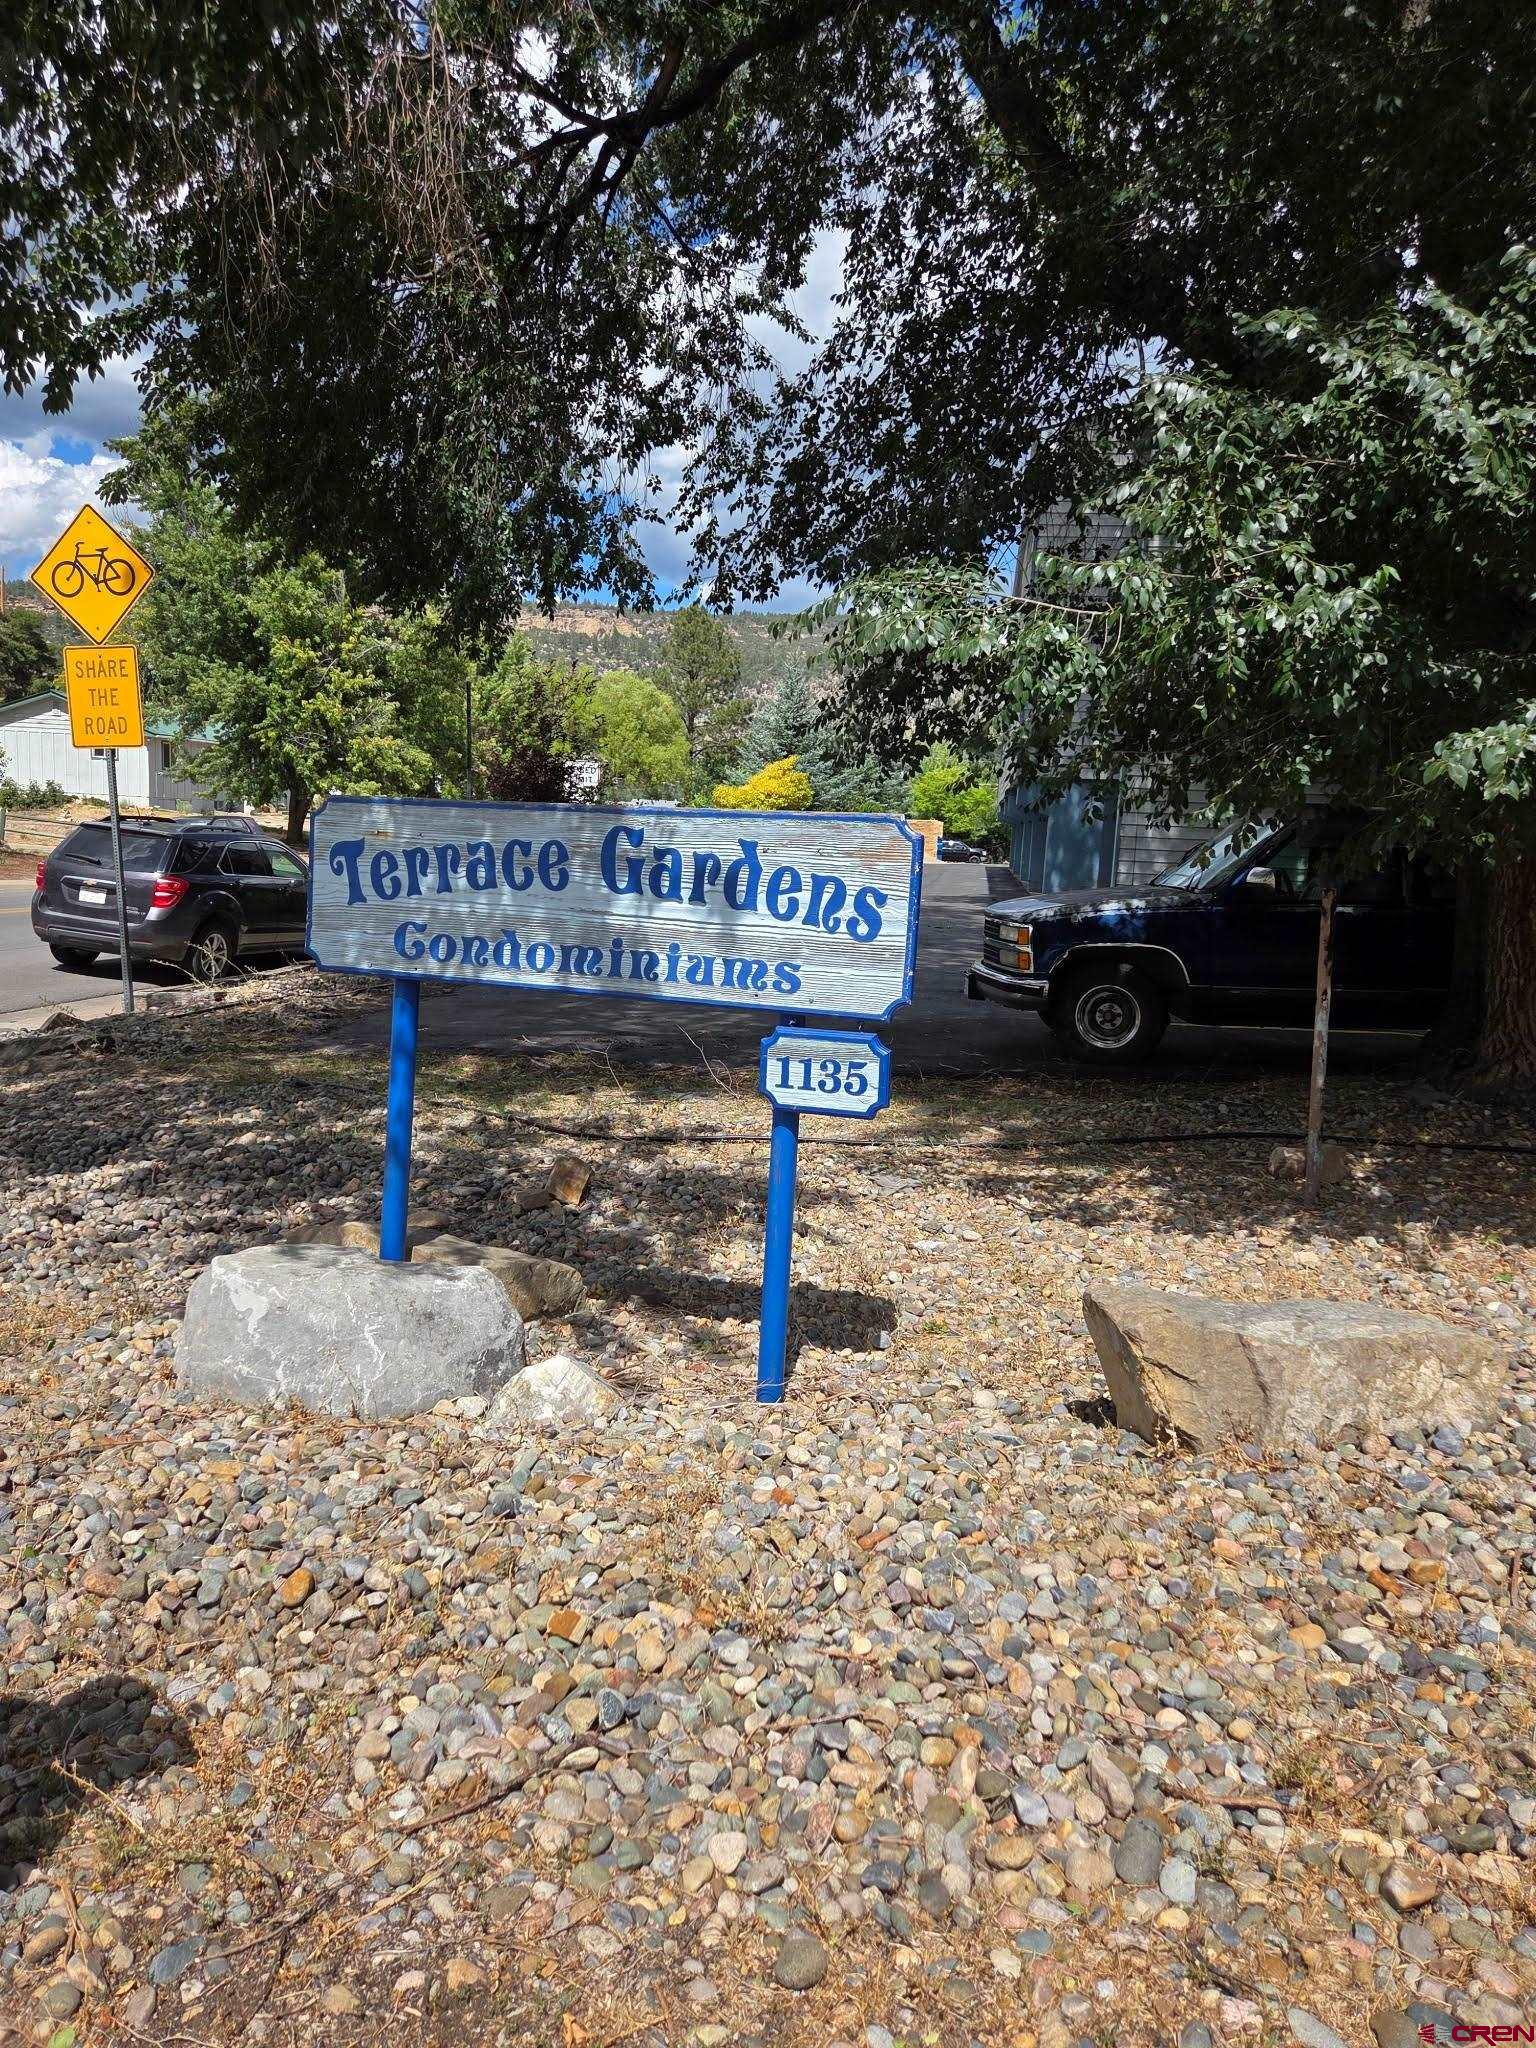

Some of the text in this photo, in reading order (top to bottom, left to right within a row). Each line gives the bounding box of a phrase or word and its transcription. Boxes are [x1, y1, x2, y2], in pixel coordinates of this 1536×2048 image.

[75, 659, 128, 678] SHARE
[88, 687, 119, 706] THE
[84, 716, 127, 735] ROAD
[329, 825, 889, 943] Terrace Gardens
[393, 921, 802, 994] Condominiums
[774, 1056, 868, 1097] 1135
